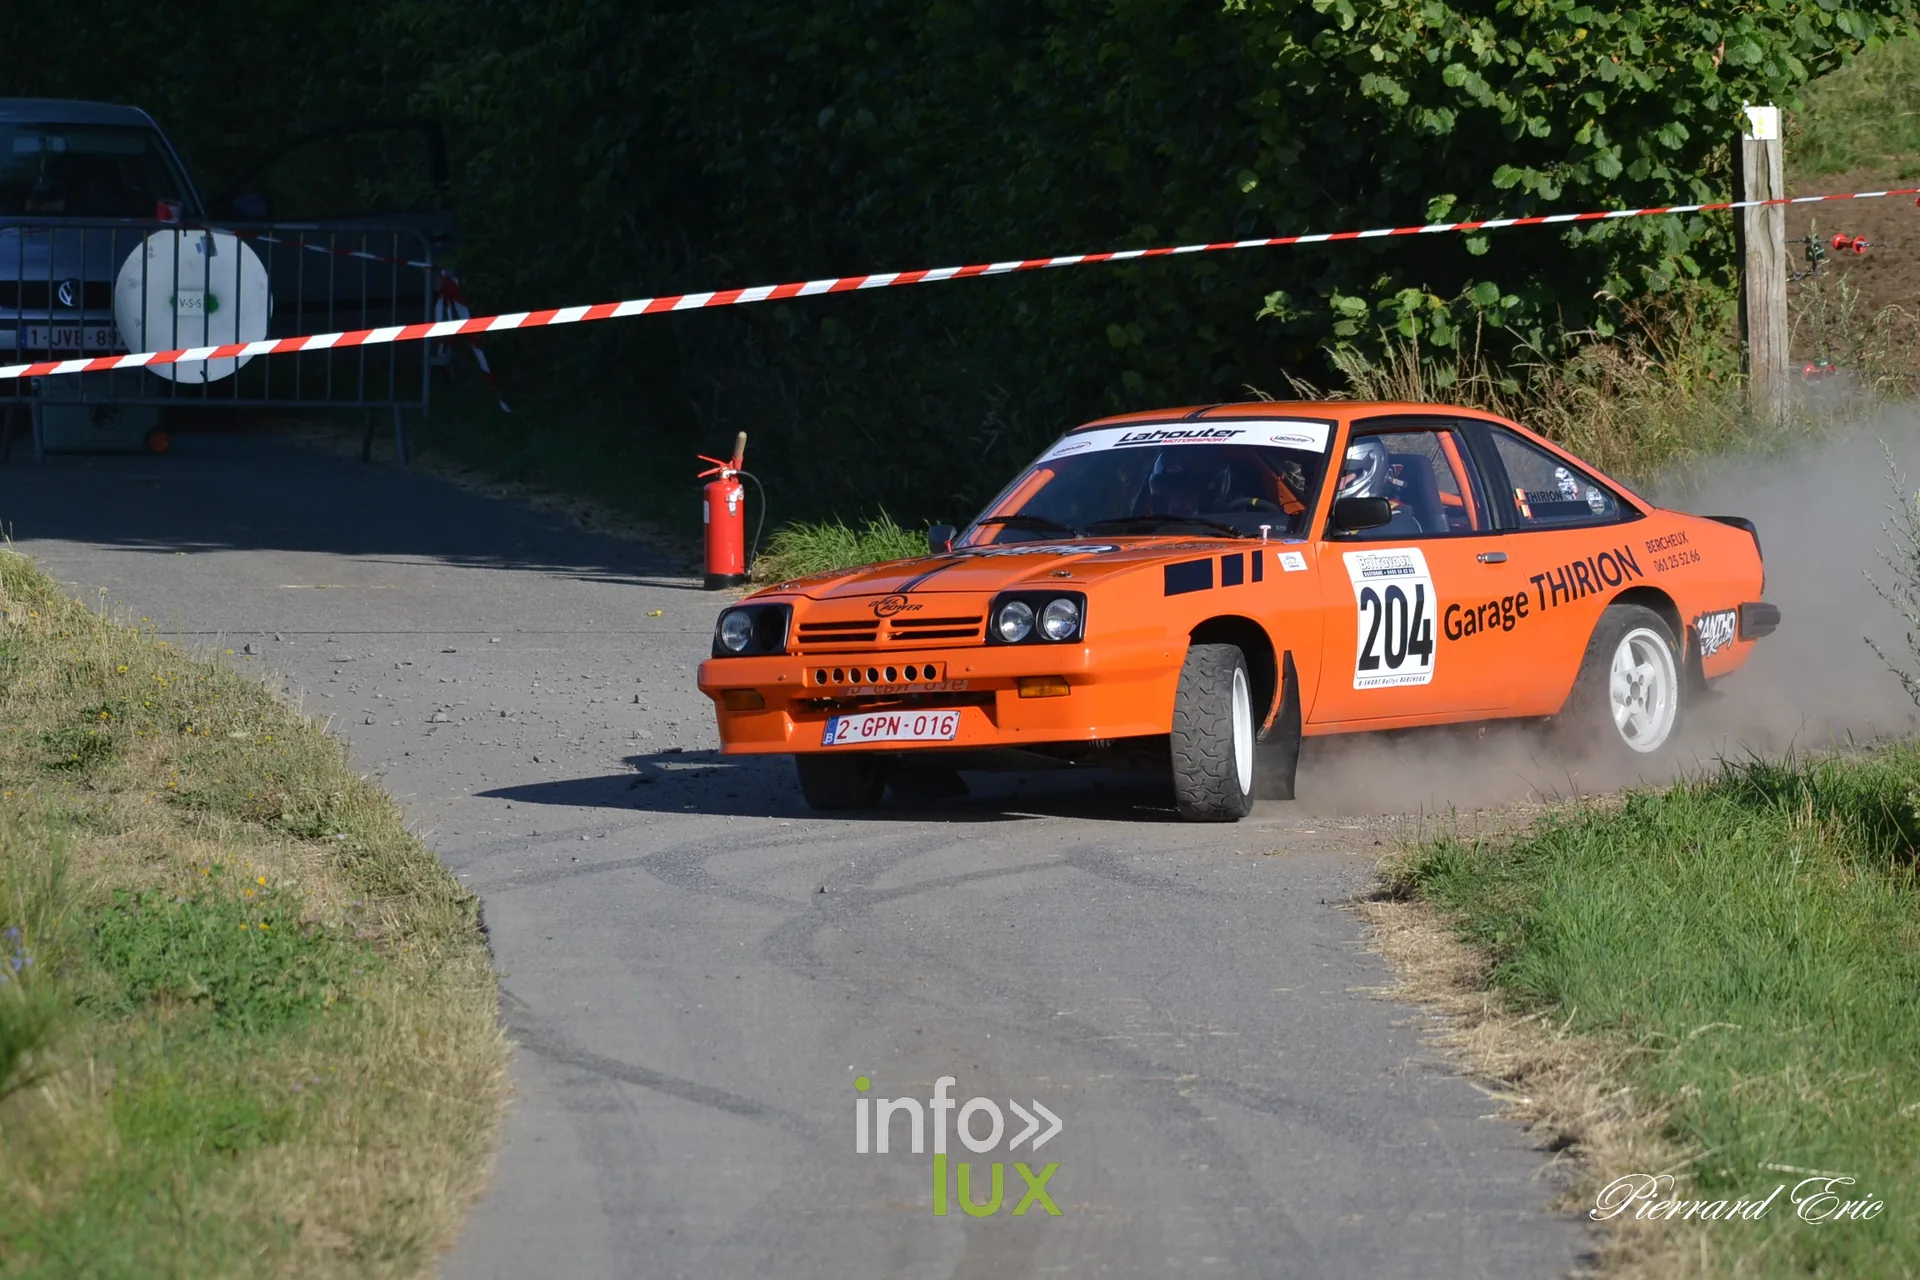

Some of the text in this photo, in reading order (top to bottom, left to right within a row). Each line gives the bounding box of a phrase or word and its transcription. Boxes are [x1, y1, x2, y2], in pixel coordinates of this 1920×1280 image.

[1121, 428, 1246, 442] Lahouter
[1524, 490, 1563, 503] THIRION
[1645, 530, 1689, 554] BERCHEUX
[1653, 548, 1701, 572] 061 25 52 66
[1444, 544, 1644, 641] Garage THIRION
[880, 604, 923, 612] POWER
[1358, 584, 1433, 671] 204
